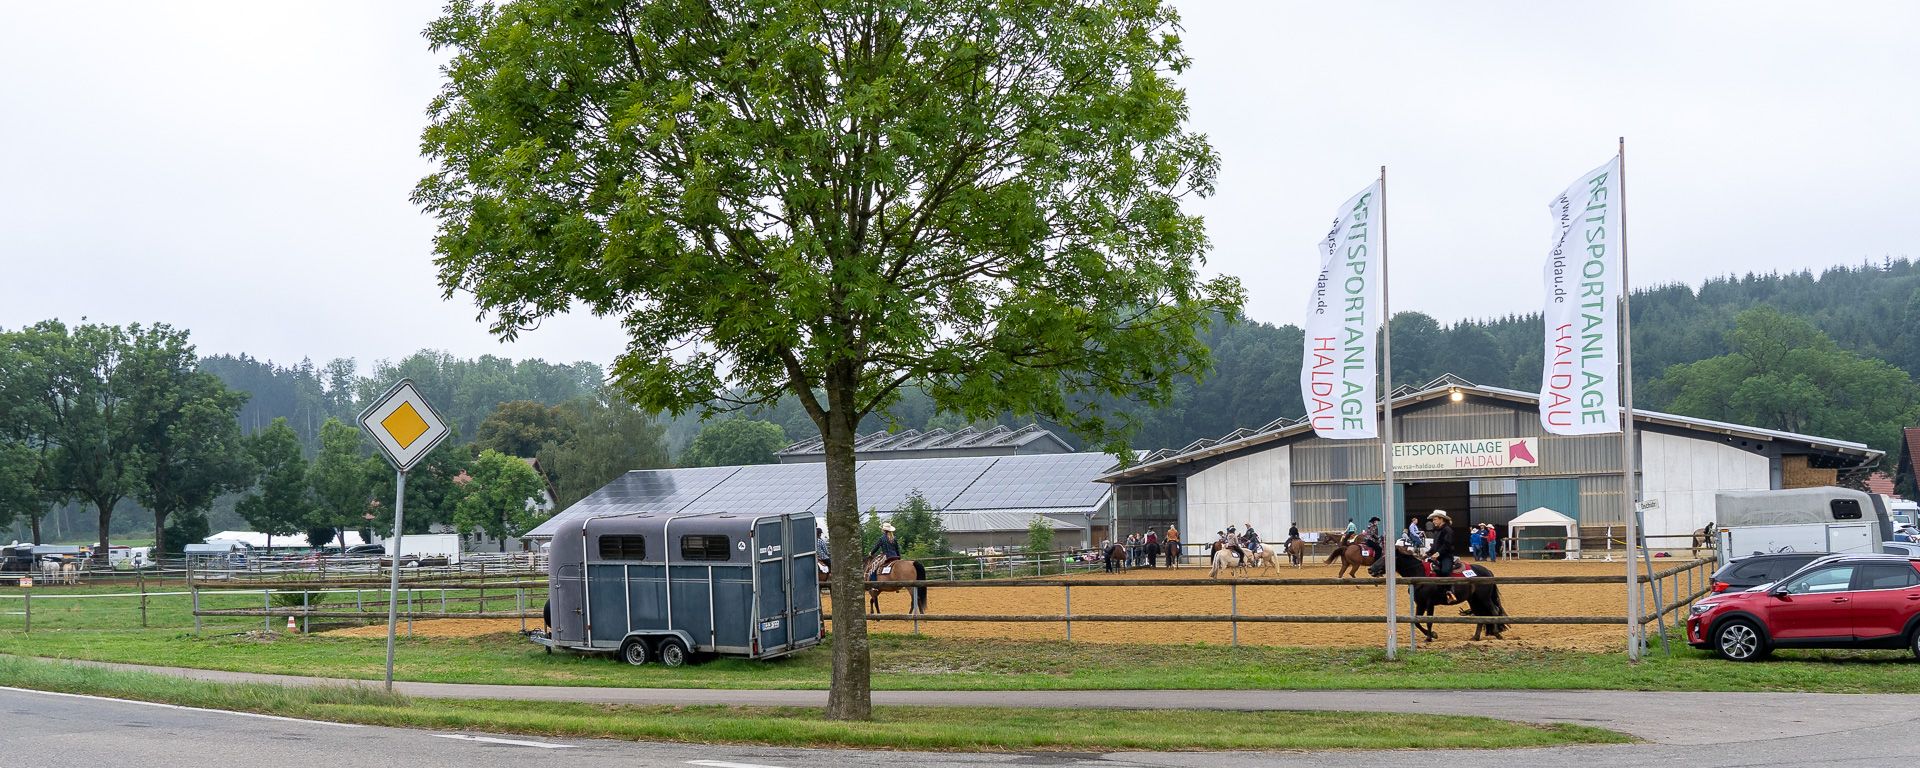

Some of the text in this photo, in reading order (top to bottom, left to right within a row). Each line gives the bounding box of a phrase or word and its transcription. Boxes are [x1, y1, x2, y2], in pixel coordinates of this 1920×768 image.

[1312, 337, 1336, 430] HALDAU
[1548, 324, 1572, 426] HALDAU
[1455, 454, 1503, 468] HALDAU
